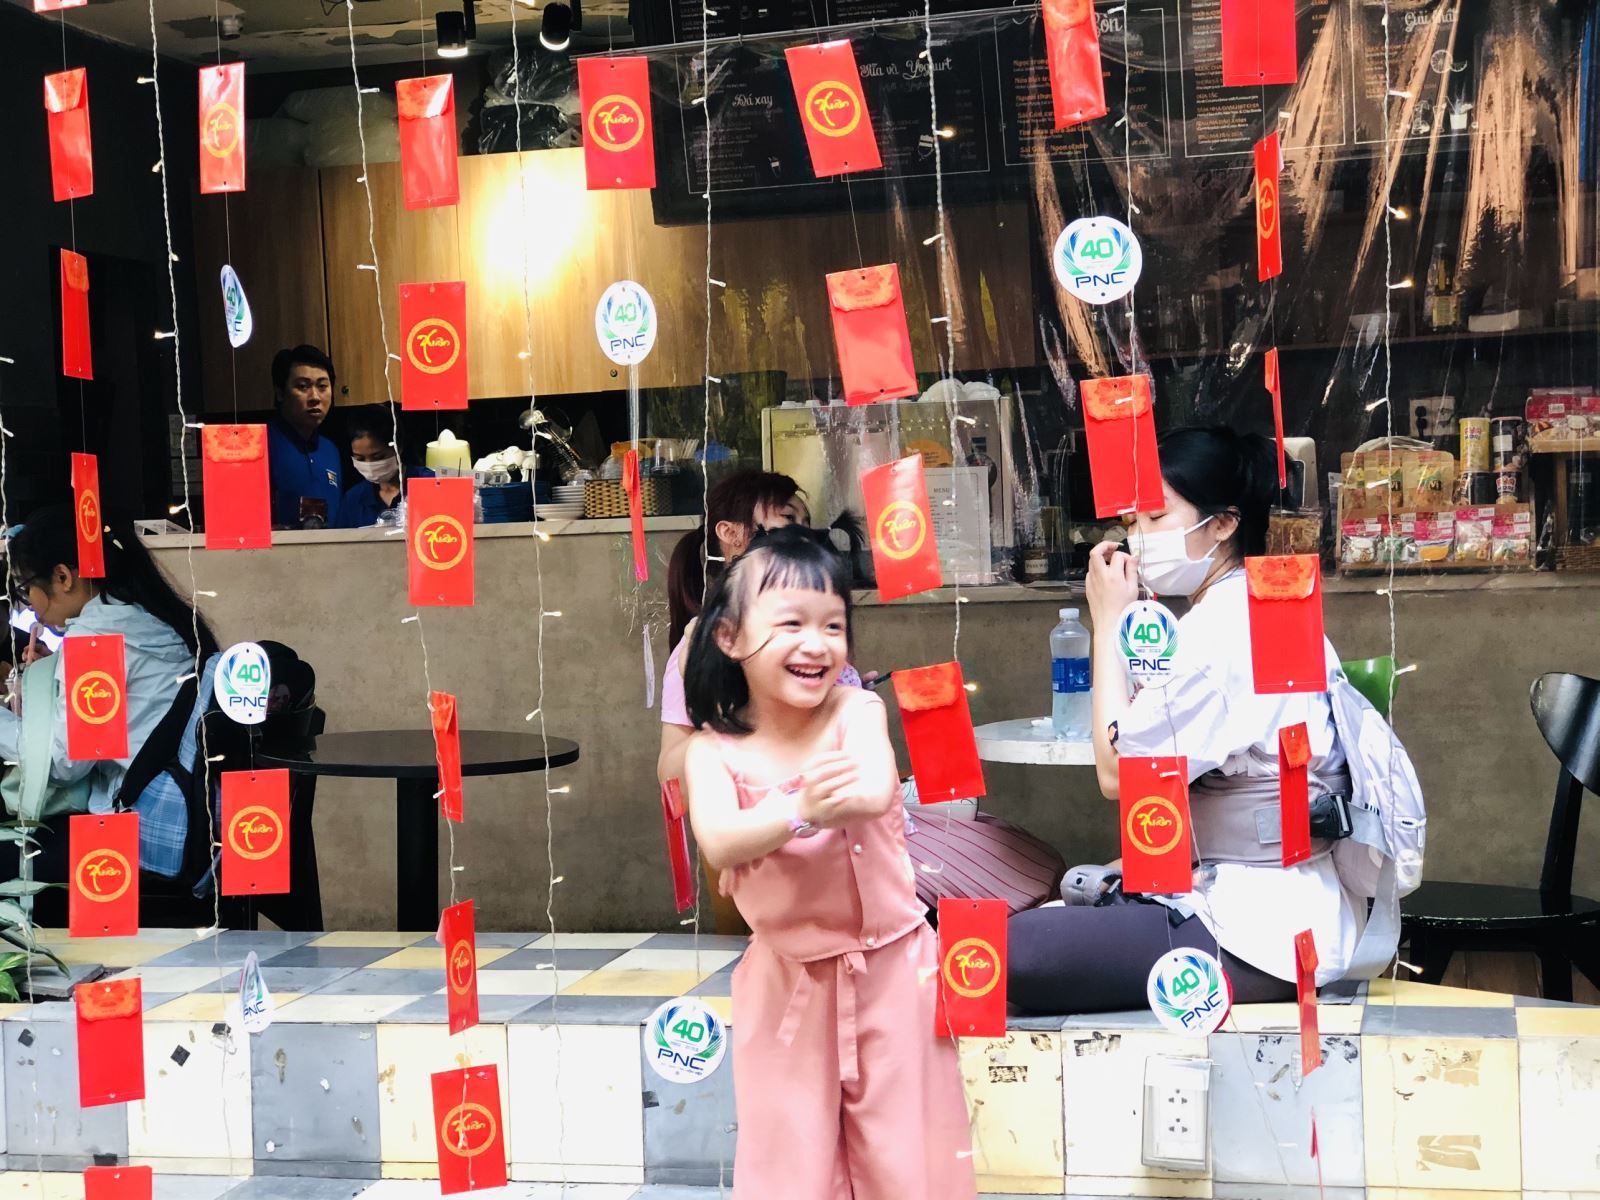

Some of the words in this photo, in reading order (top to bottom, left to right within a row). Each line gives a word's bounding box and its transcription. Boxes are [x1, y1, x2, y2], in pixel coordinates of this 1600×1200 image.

[755, 95, 773, 109] xay
[1081, 238, 1114, 259] 40
[1075, 271, 1126, 288] PNC
[615, 302, 637, 323] 40
[610, 334, 646, 352] PNC
[1133, 623, 1160, 644] 40
[236, 664, 261, 683] 40
[1129, 658, 1171, 671] PNC
[229, 696, 267, 707] PNC
[1172, 967, 1200, 997] 40
[1180, 991, 1222, 1028] PNC
[672, 1019, 705, 1043] 40
[657, 1047, 706, 1071] PNC
